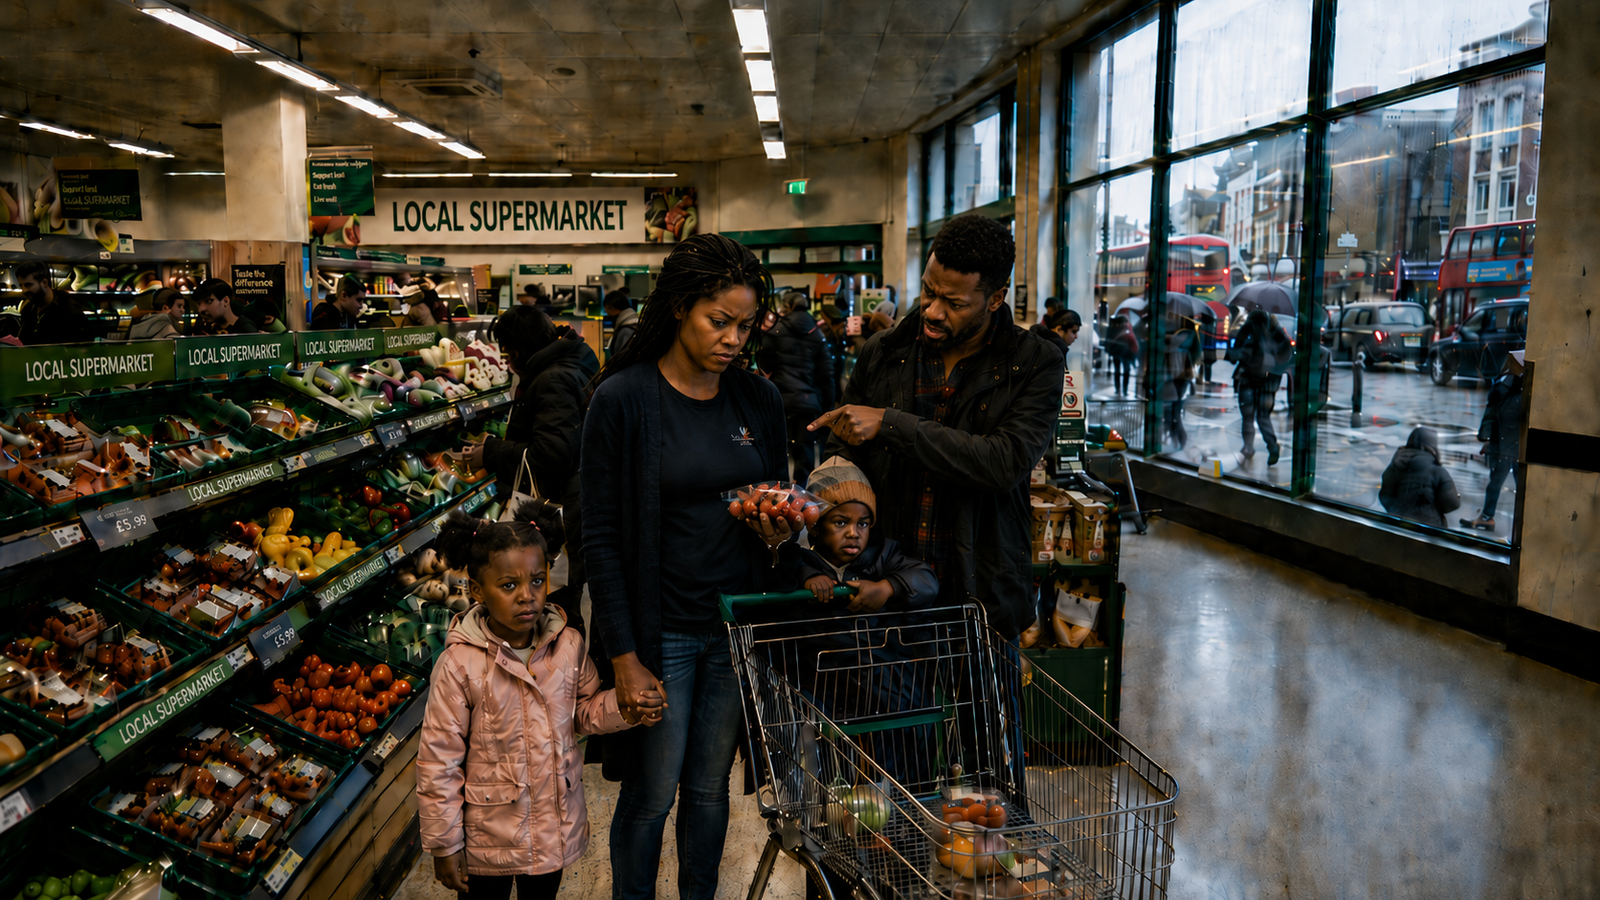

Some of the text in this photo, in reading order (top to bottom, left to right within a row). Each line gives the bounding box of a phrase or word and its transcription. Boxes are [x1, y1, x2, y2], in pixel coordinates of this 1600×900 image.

[392, 200, 628, 232] LOCAL SUPERMARKET
[253, 269, 266, 278] the
[188, 343, 281, 366] LOCAL SUPERMARKET
[304, 337, 376, 356] LOCAL SUPERMARKET
[25, 354, 154, 382] LOCAL SUPERMARKET
[187, 463, 275, 502] LOCAL SUPERMARKET
[116, 514, 148, 533] £5.99
[274, 627, 296, 648] £5.99
[118, 664, 226, 744] LOCAL SUPERMARKET
